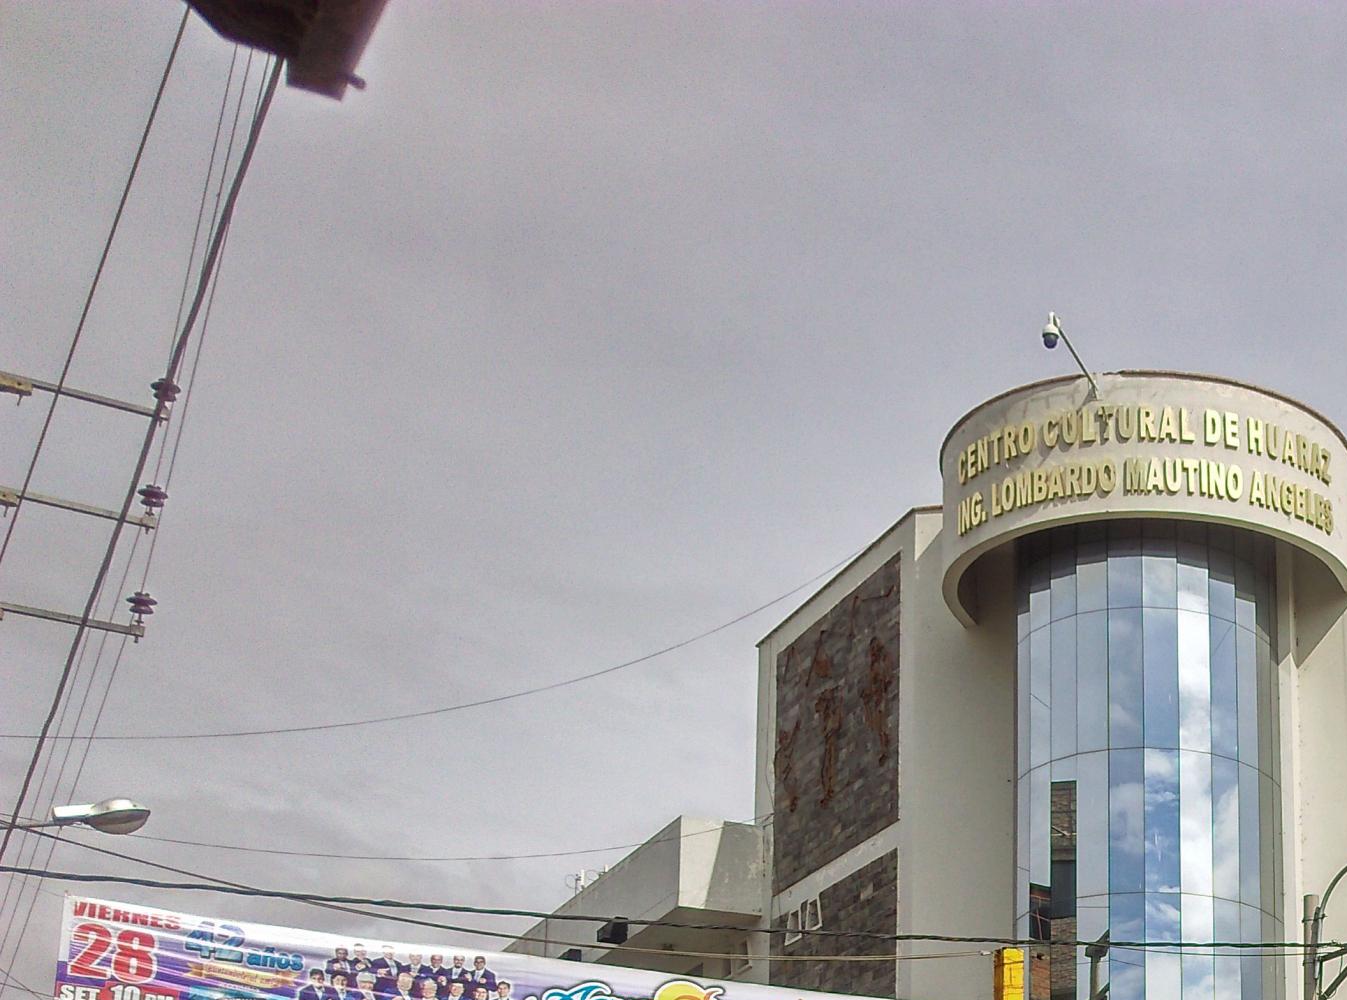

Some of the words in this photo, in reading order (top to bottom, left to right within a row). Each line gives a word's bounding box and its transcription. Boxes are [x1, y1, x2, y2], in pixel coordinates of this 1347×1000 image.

[958, 421, 1036, 485] CENTRO
[1042, 404, 1195, 449] CULTURAL
[1204, 408, 1240, 449] DE
[1247, 416, 1332, 486] HUARAZ
[957, 491, 988, 536] ING.
[991, 455, 1116, 517] LOMBARDO
[1123, 456, 1243, 502] MAUTINO
[1249, 470, 1334, 535] ANGELES
[73, 901, 182, 930] VIERNES
[68, 922, 158, 984] 28
[246, 946, 304, 971] años
